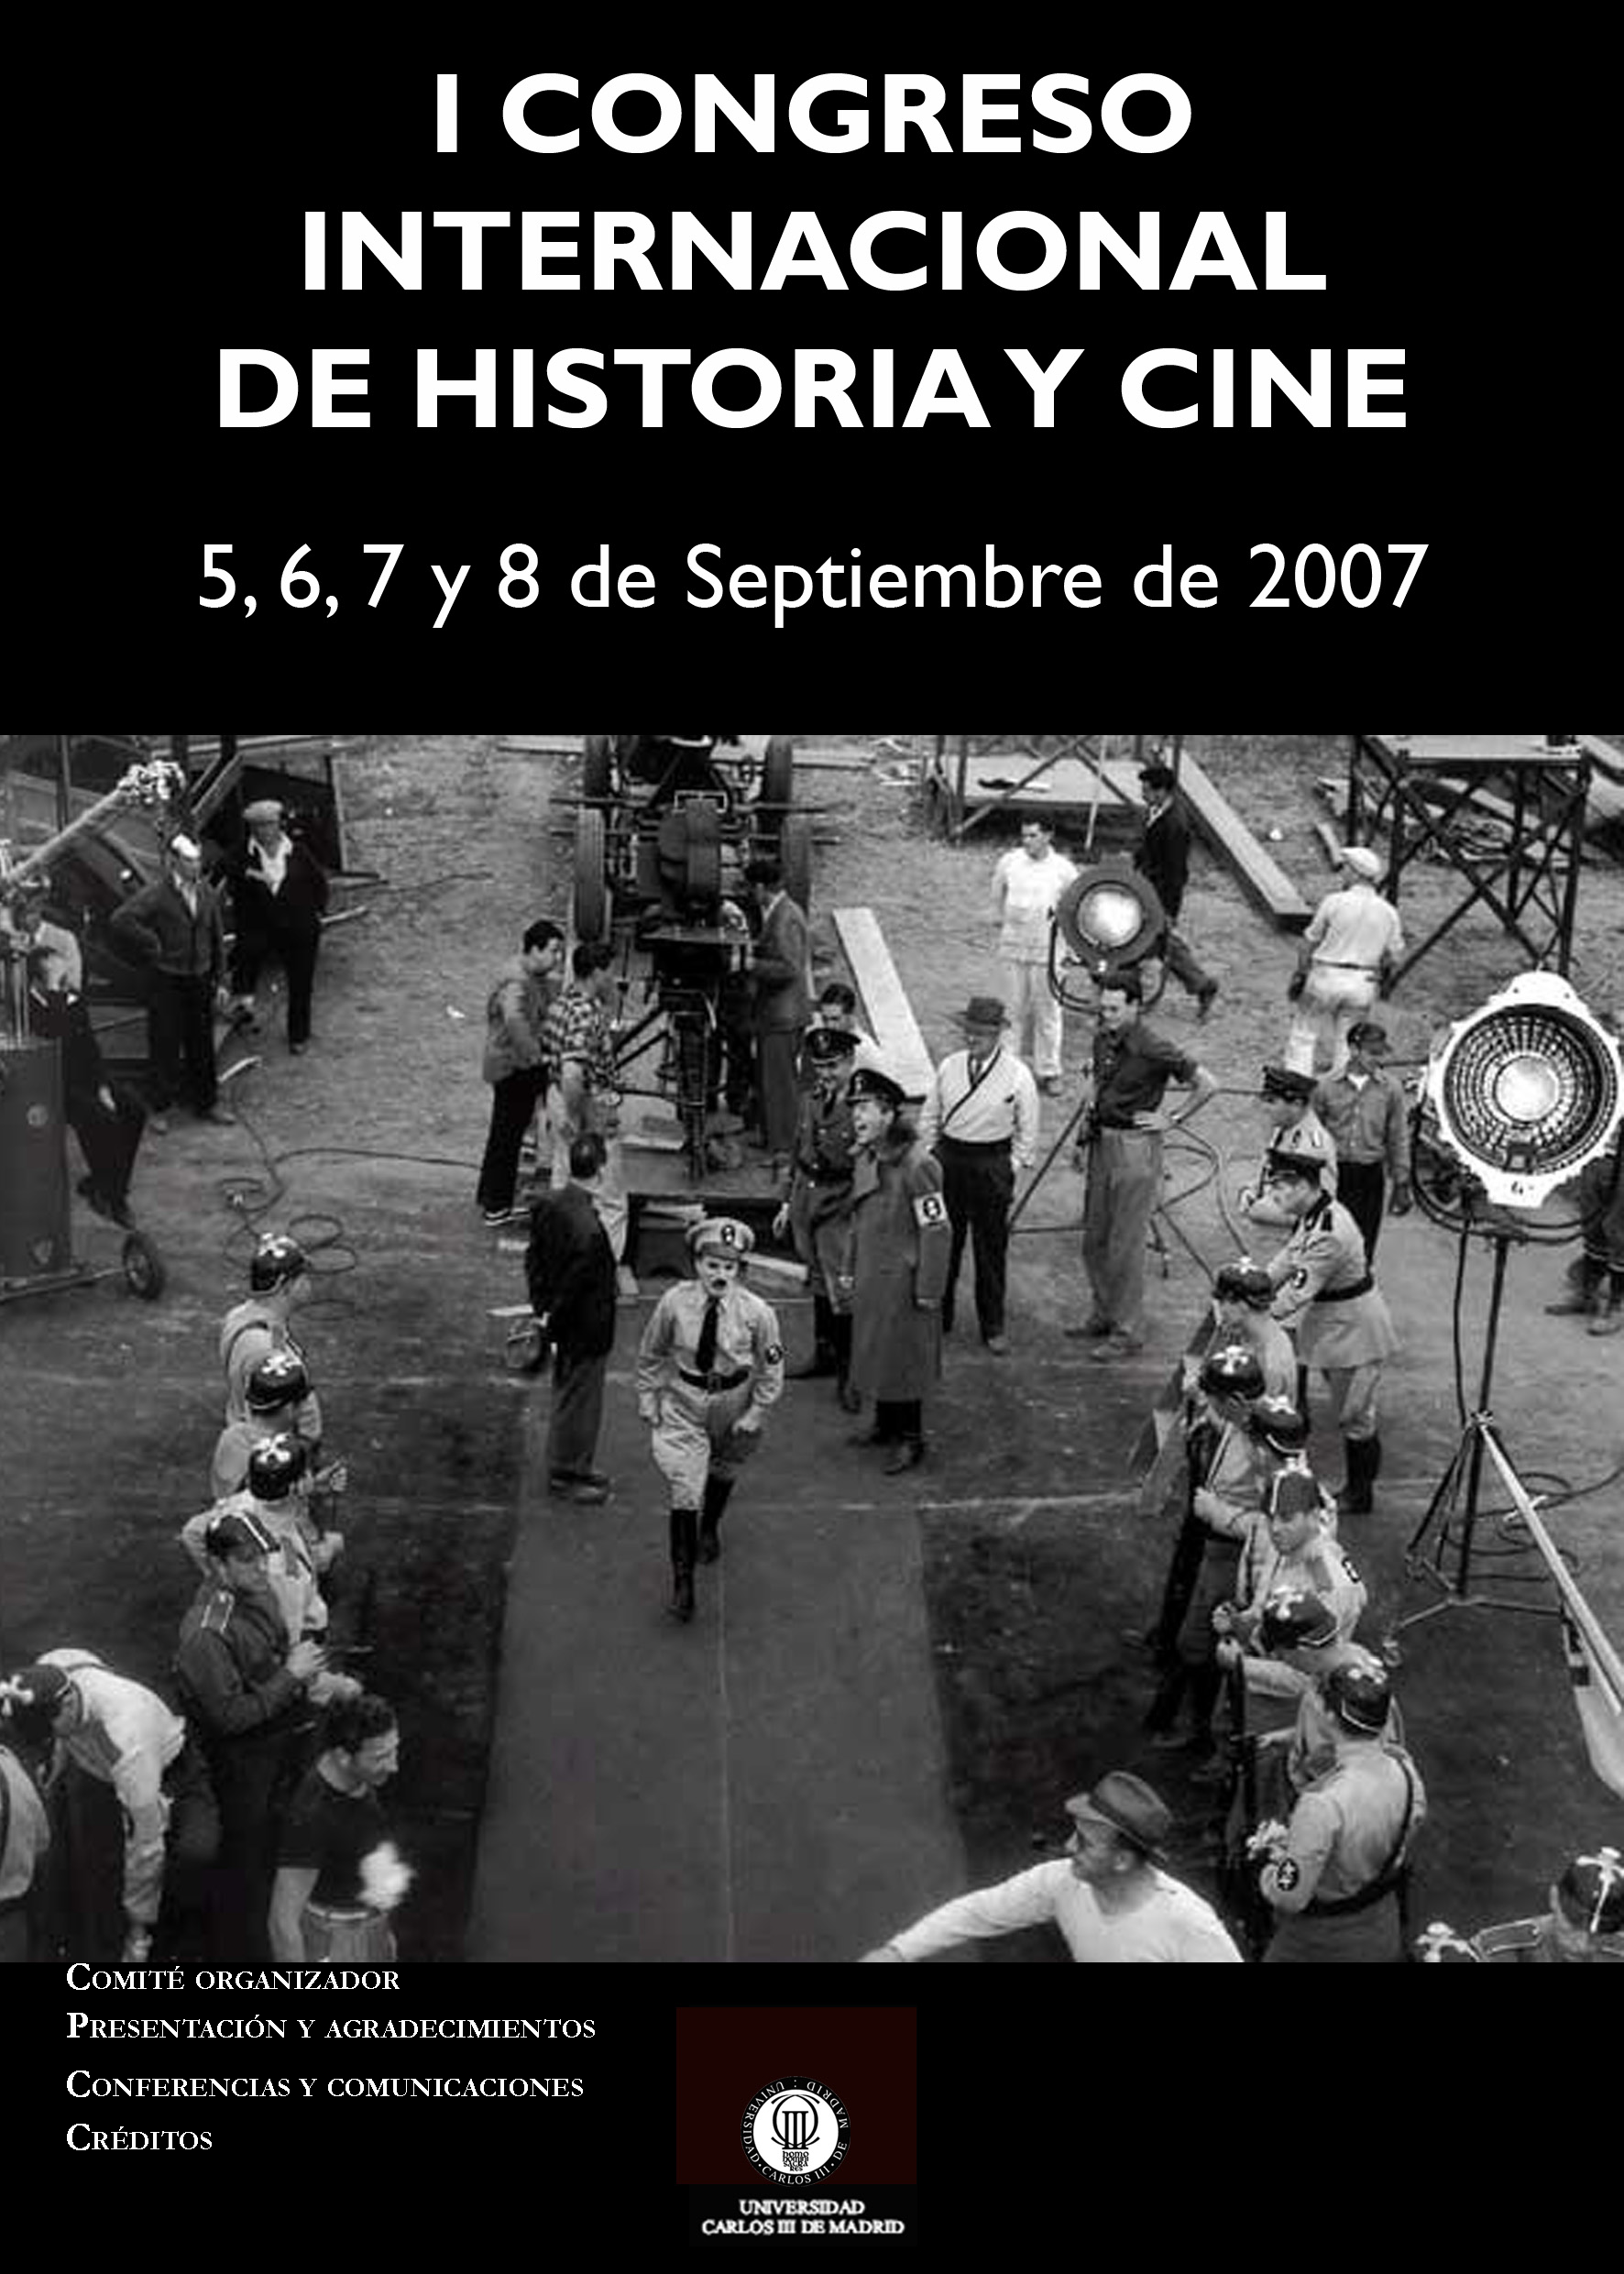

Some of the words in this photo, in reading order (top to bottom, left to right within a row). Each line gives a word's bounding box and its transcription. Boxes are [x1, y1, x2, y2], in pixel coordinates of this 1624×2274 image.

[437, 73, 457, 153] I
[503, 73, 1191, 153] CONGRESO
[305, 211, 1326, 291] INTERNACIONAL
[220, 348, 370, 428] DE
[417, 348, 991, 428] HISTORIA
[1004, 348, 1084, 428] Y
[1122, 348, 1406, 428] CINE
[200, 544, 257, 618] 5,
[280, 544, 338, 618] 6,
[364, 544, 404, 608] 7
[431, 566, 471, 628] y
[499, 544, 539, 608] 8
[571, 544, 655, 608] de
[687, 544, 1102, 628] Septiembre
[1134, 544, 1218, 608] de
[1249, 544, 1429, 608] 2007
[196, 1971, 400, 1990] ORGANIZADOR
[297, 2019, 315, 2038] Y
[324, 2019, 595, 2038] AGRADECIMIENTOS
[299, 2079, 317, 2096] Y
[328, 2079, 583, 2097] COMUNICACIONES
[807, 2082, 849, 2128] MADRID
[743, 2082, 785, 2162] UNIVERSIDAD
[833, 2141, 847, 2160] DE
[762, 2166, 811, 2184] CARLOS
[739, 2200, 865, 2215] UNIVERSIDAD
[702, 2219, 774, 2235] CARLOS
[777, 2219, 796, 2234] III
[801, 2219, 826, 2234] DE
[828, 2219, 905, 2234] MADRID
